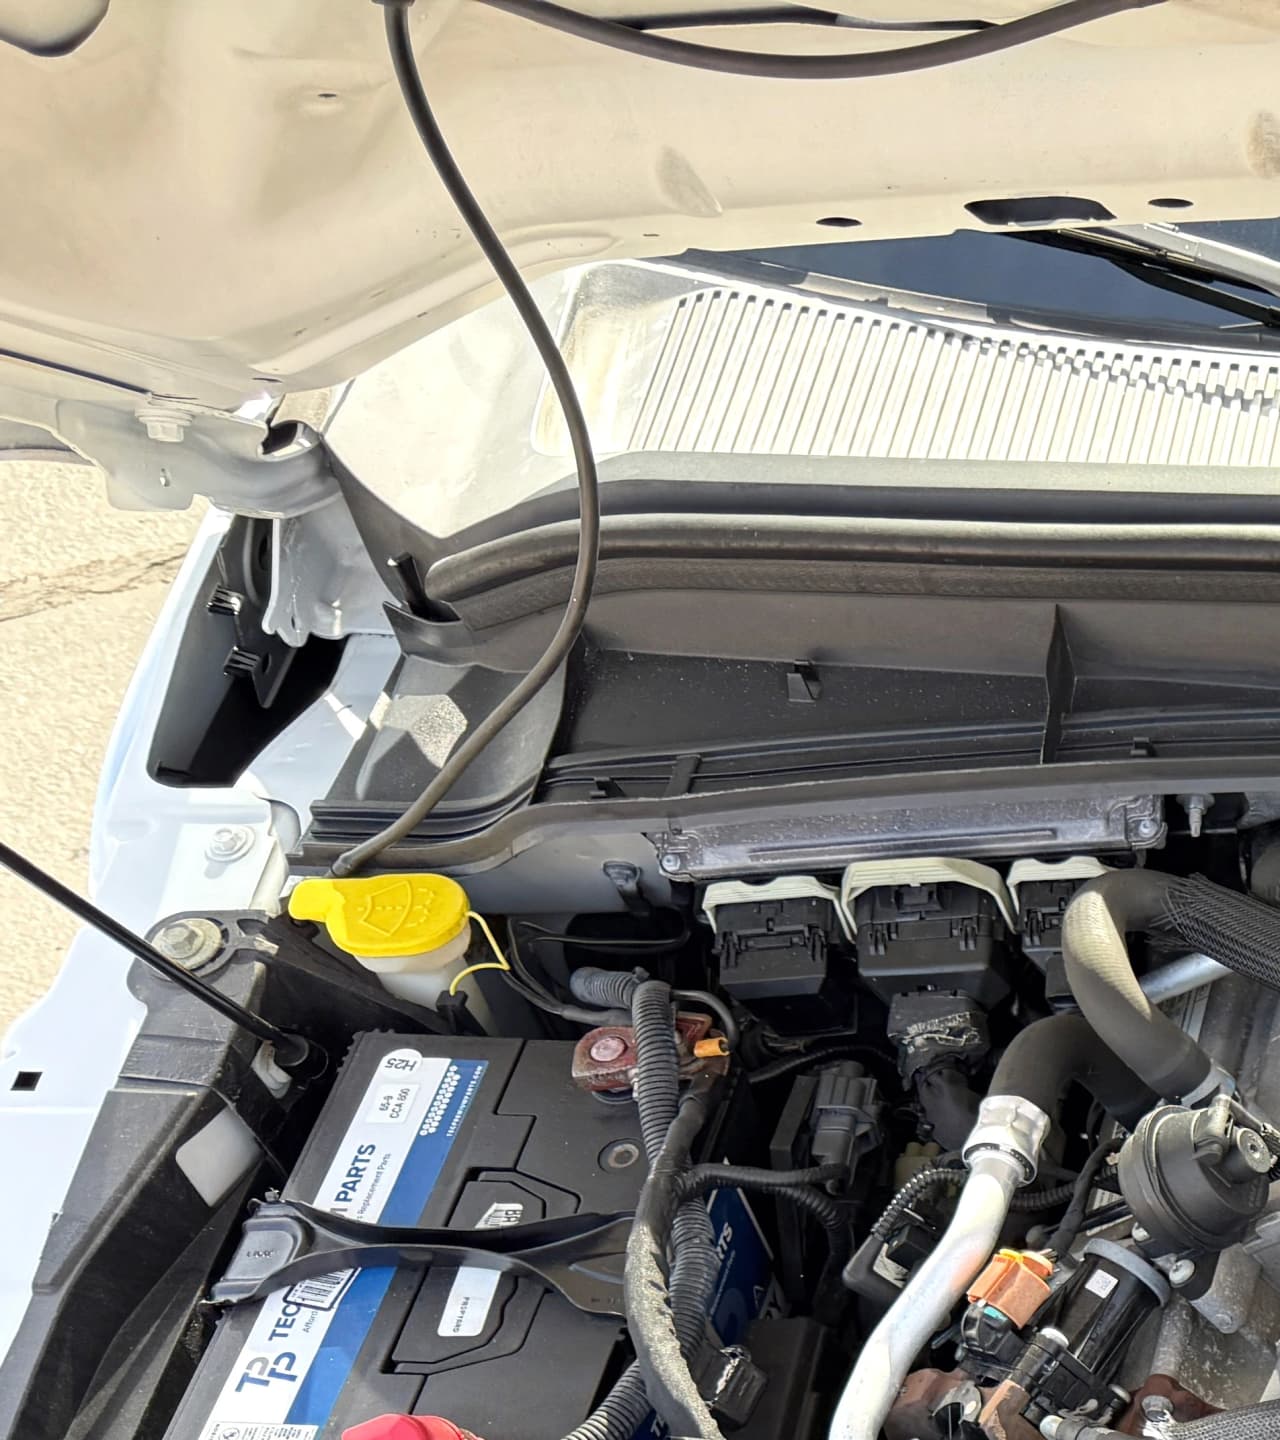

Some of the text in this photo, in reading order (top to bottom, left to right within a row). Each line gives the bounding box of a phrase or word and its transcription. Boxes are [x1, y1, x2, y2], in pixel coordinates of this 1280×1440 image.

[385, 1058, 417, 1071] H25
[390, 1101, 404, 1119] CCA
[334, 1143, 376, 1203] PARTS
[356, 1151, 392, 1217] Replacement Parts
[267, 1300, 301, 1341] TEC
